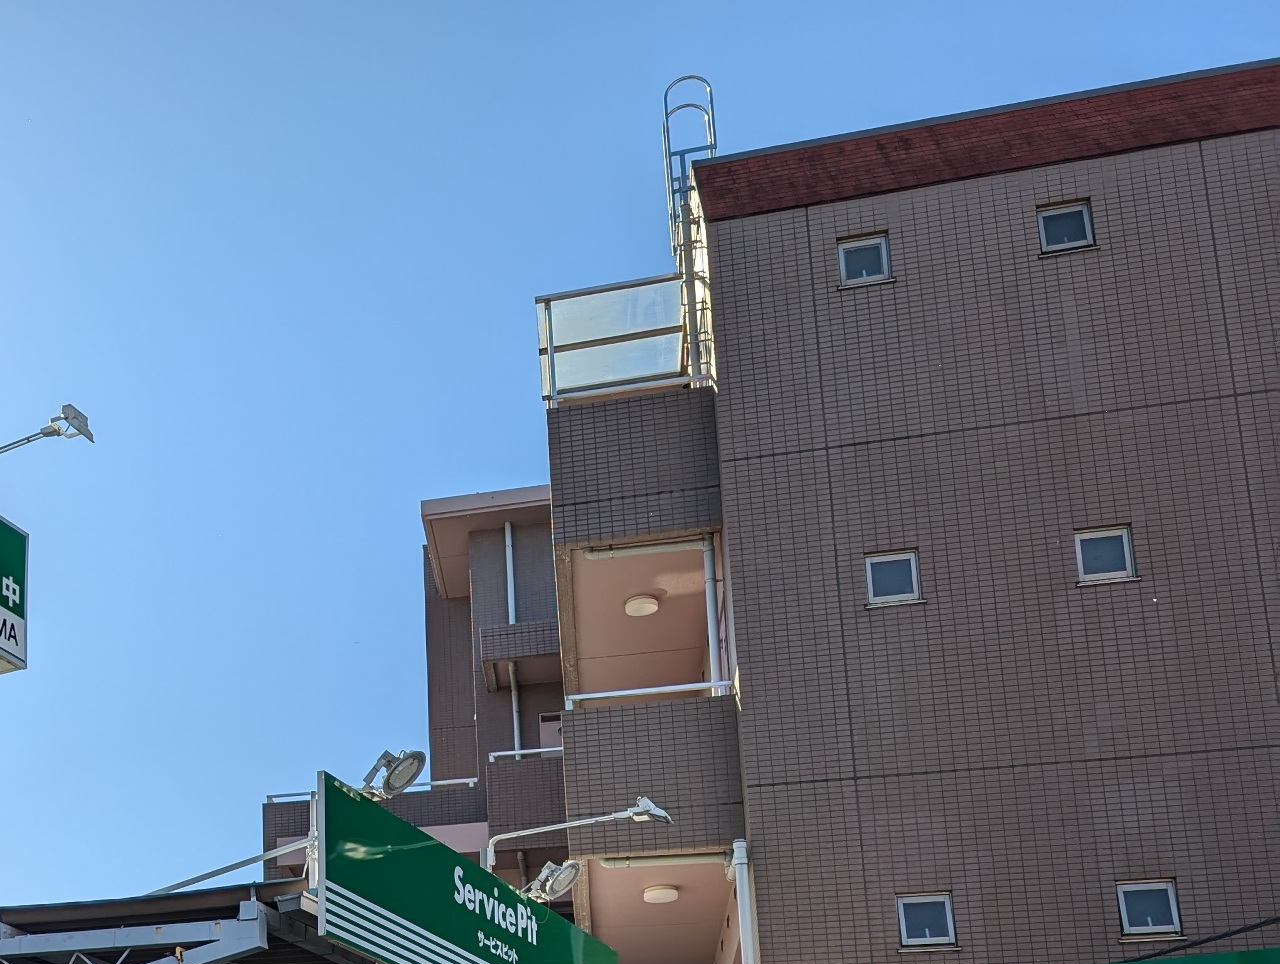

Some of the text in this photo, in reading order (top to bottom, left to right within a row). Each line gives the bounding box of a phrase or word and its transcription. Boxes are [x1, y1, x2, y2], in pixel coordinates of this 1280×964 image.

[477, 930, 519, 964] サービスピット
